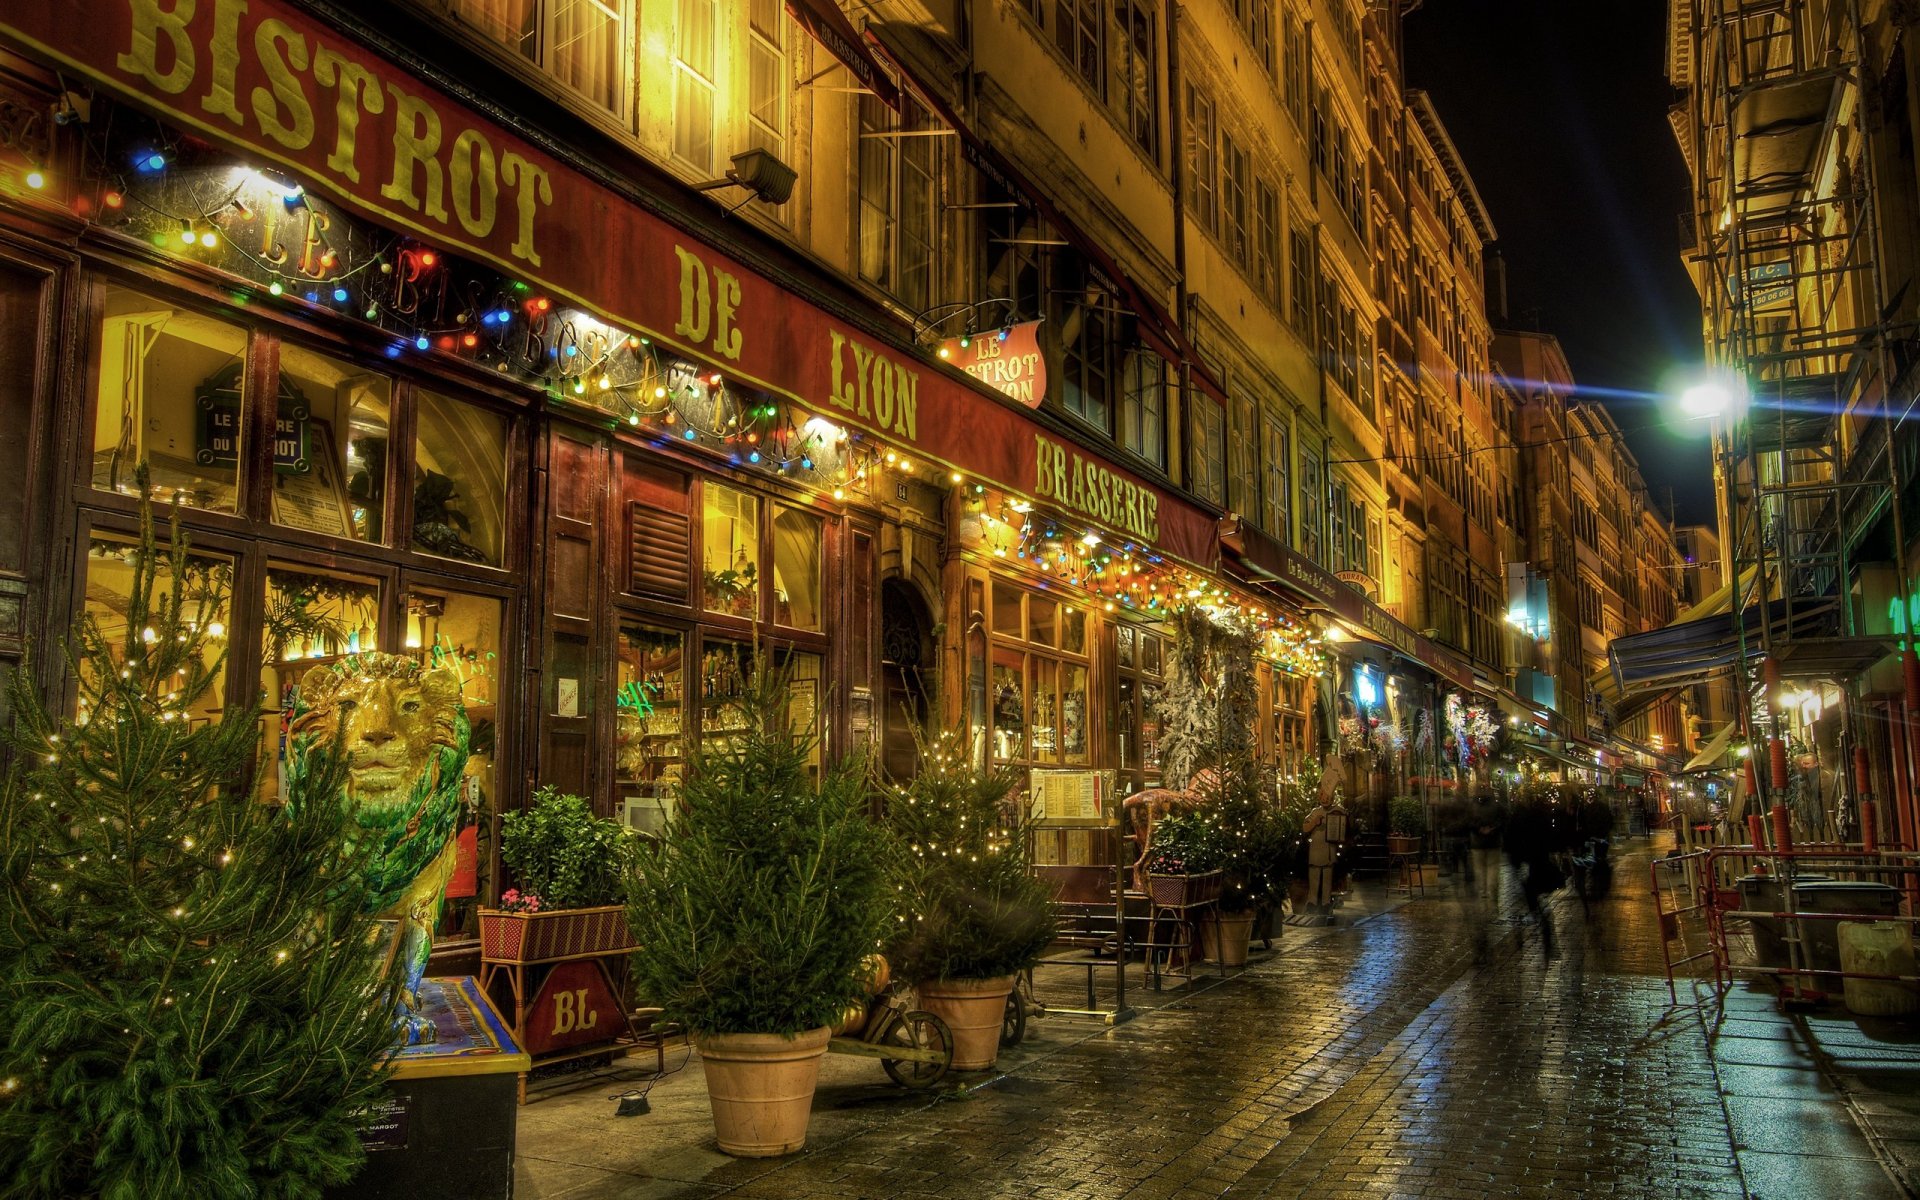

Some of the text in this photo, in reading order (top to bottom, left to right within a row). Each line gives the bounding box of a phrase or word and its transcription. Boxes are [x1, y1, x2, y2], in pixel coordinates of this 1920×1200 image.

[820, 23, 870, 79] BRASSERIE
[258, 188, 331, 279] LE
[117, 0, 1159, 543] BISTROT DE LYON BRASSERIE
[976, 336, 1001, 361] LE
[961, 353, 1039, 384] STROT
[215, 413, 232, 427] LE
[213, 437, 230, 451] DU
[552, 988, 597, 1036] BL
